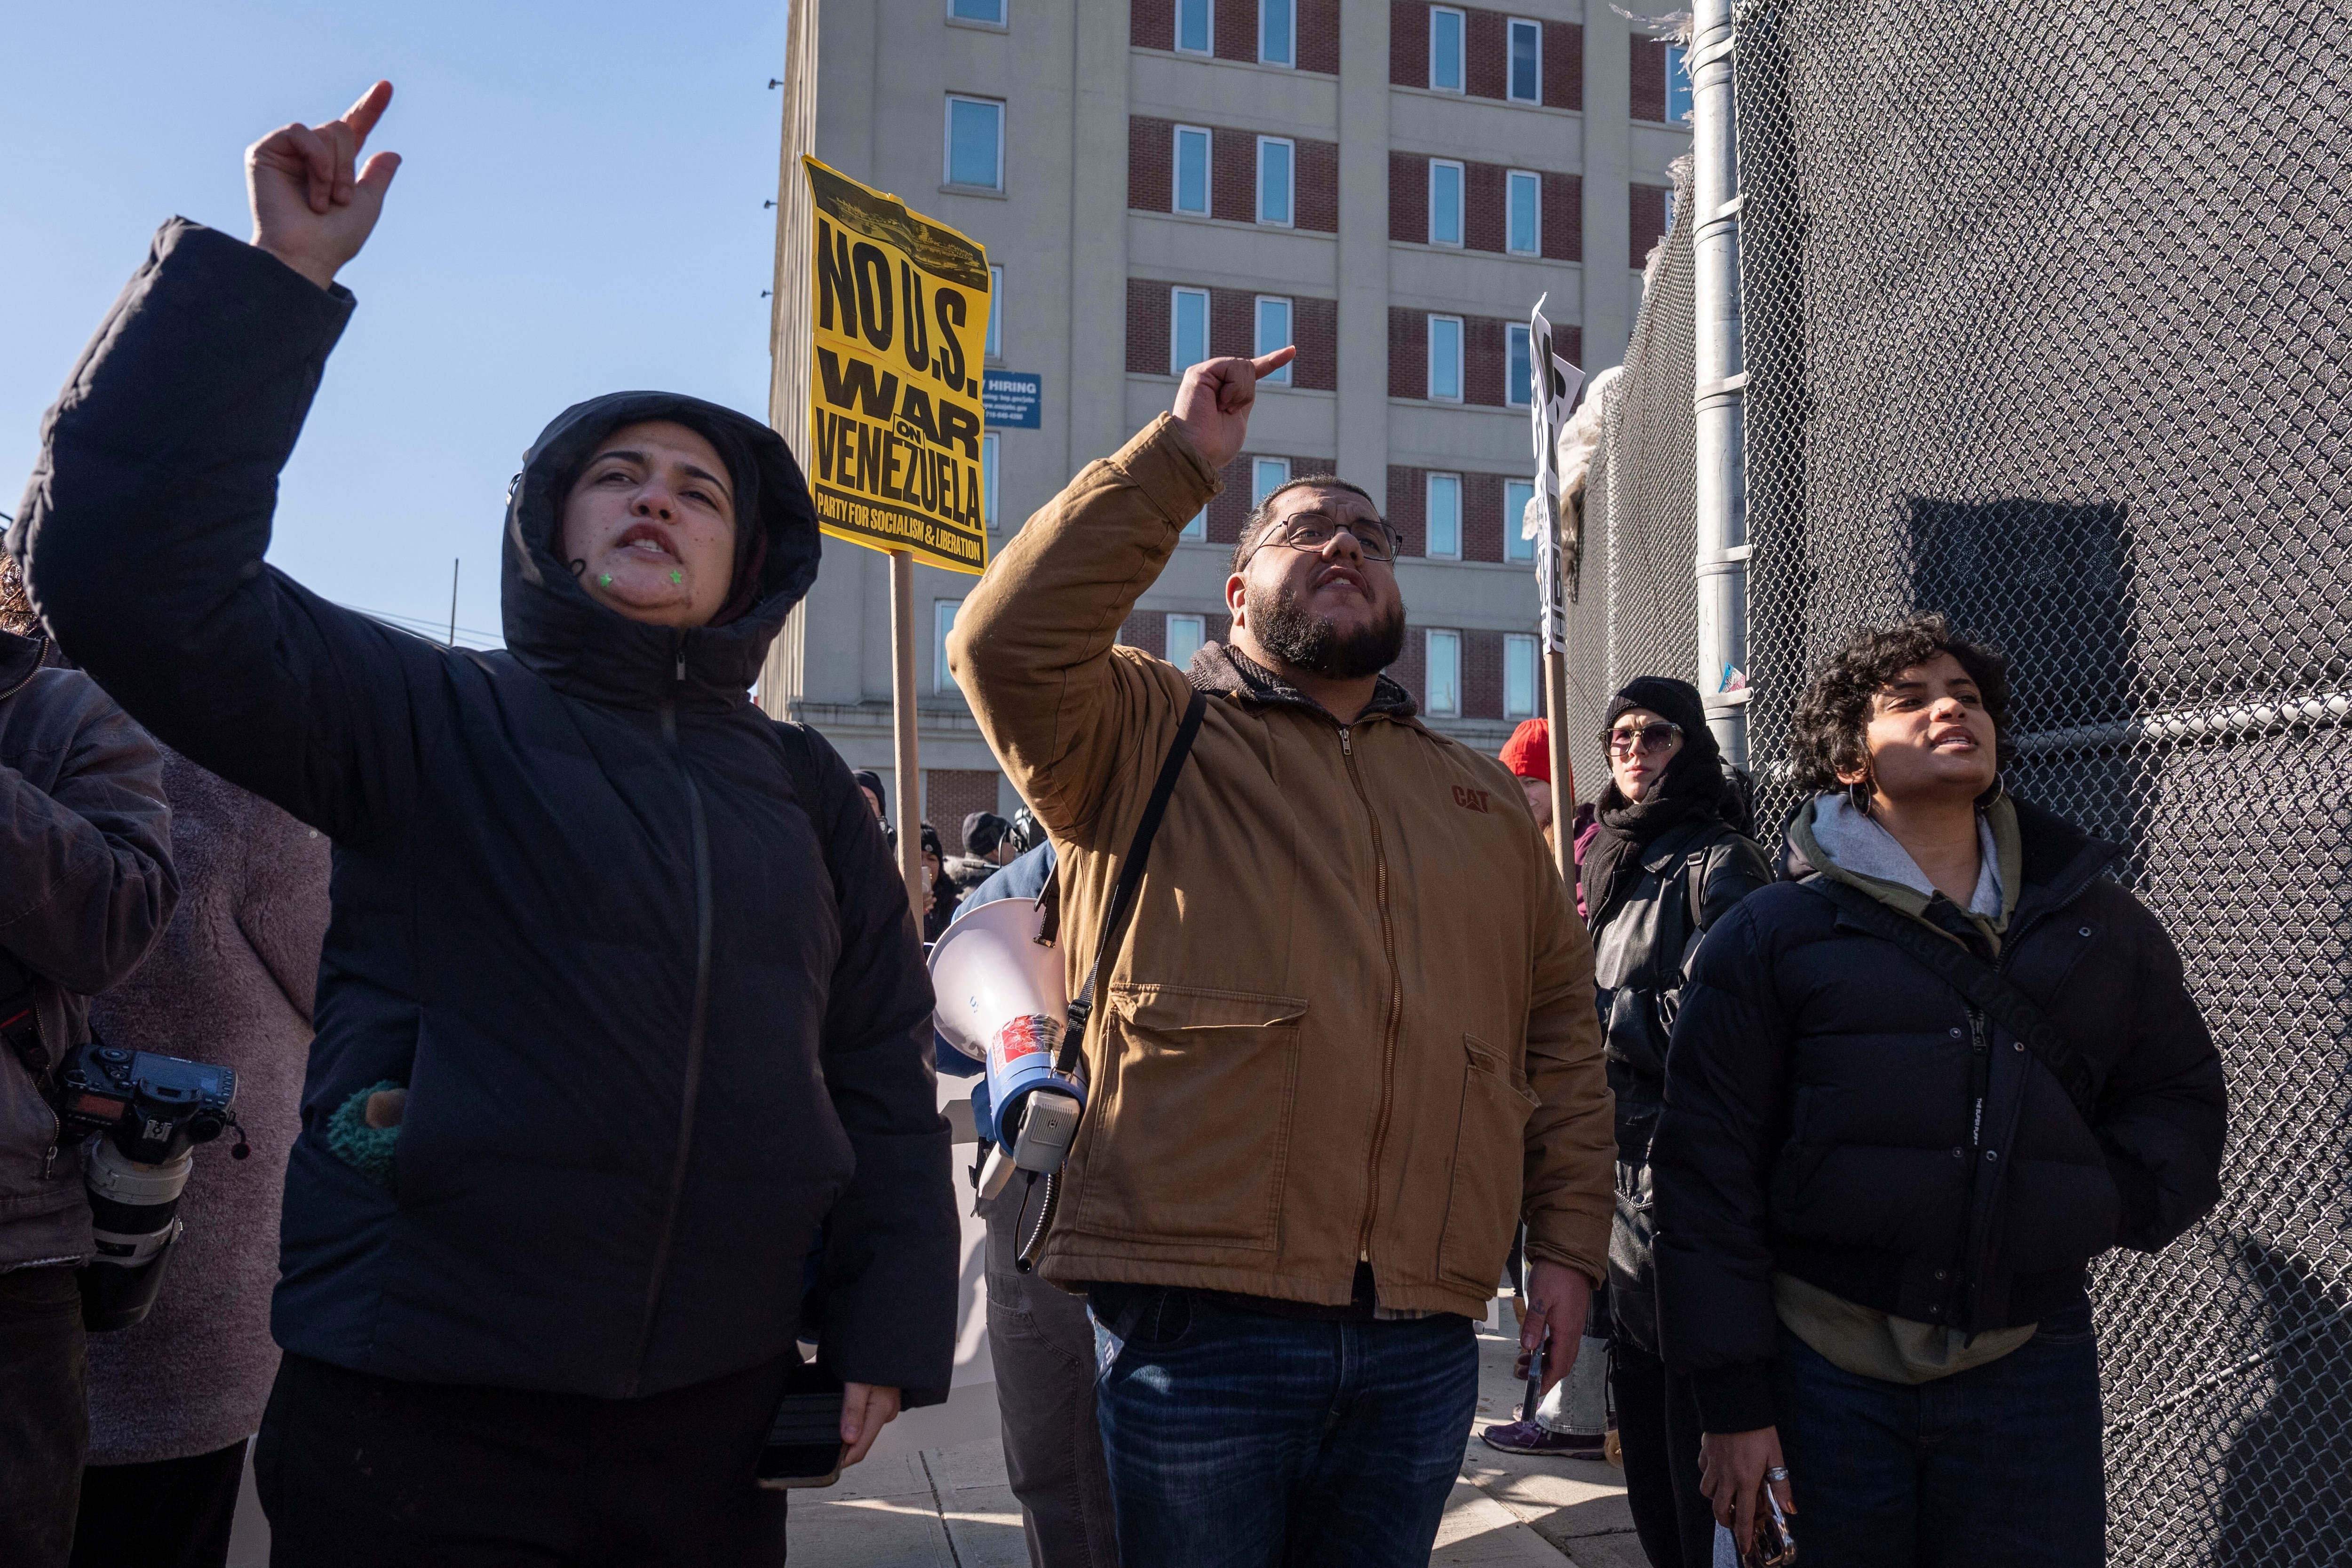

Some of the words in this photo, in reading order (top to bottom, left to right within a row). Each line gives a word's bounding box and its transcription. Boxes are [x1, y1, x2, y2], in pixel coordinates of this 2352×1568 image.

[818, 217, 893, 351] NO
[901, 259, 978, 400] U.S.
[817, 345, 980, 462] WAR
[989, 380, 1036, 394] HIRING
[897, 420, 921, 445] ON
[816, 406, 983, 531] VENEZUELA
[818, 492, 848, 522] PARTY
[849, 502, 869, 528] FOR
[870, 508, 924, 542] SOCIALISM
[925, 524, 935, 546] &
[936, 527, 981, 561] LIBERATION
[1452, 784, 1489, 814] CAT
